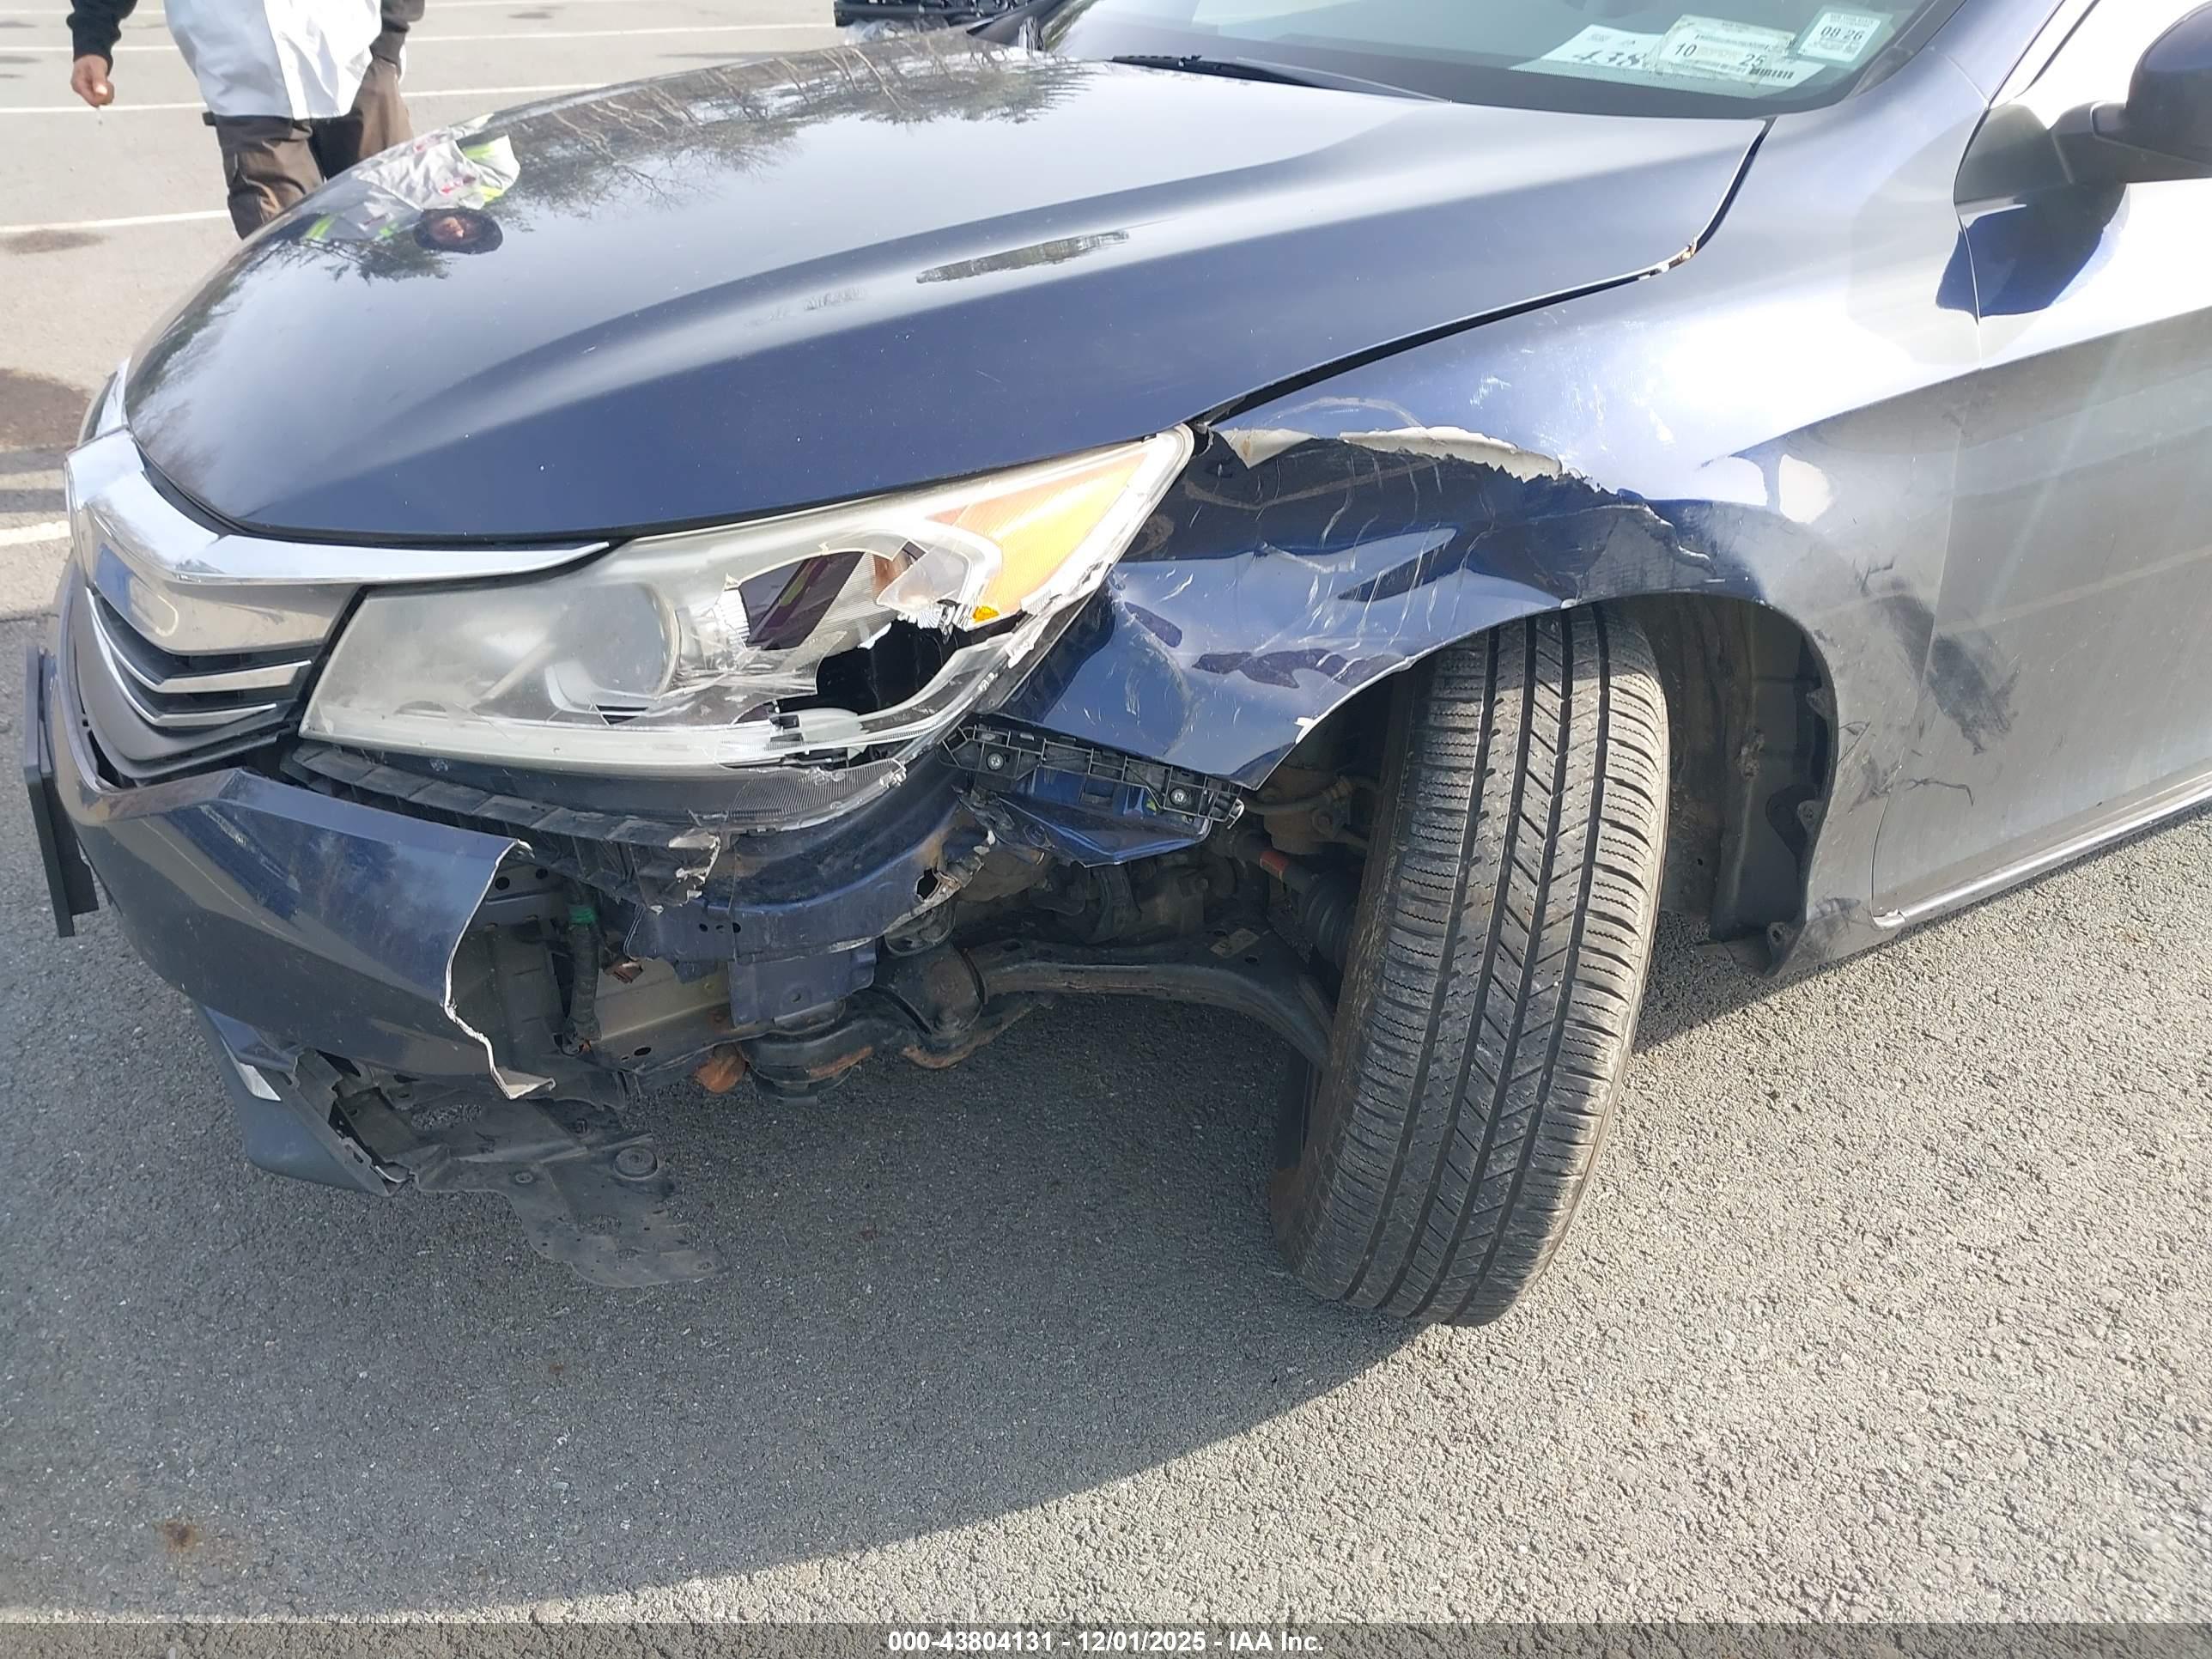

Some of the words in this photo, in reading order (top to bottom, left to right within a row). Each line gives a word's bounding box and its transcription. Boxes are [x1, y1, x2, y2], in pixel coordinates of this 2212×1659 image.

[1820, 27, 1842, 38] 08
[1842, 28, 1865, 40] 26
[1674, 42, 1698, 58] 10
[1739, 53, 1766, 68] 25
